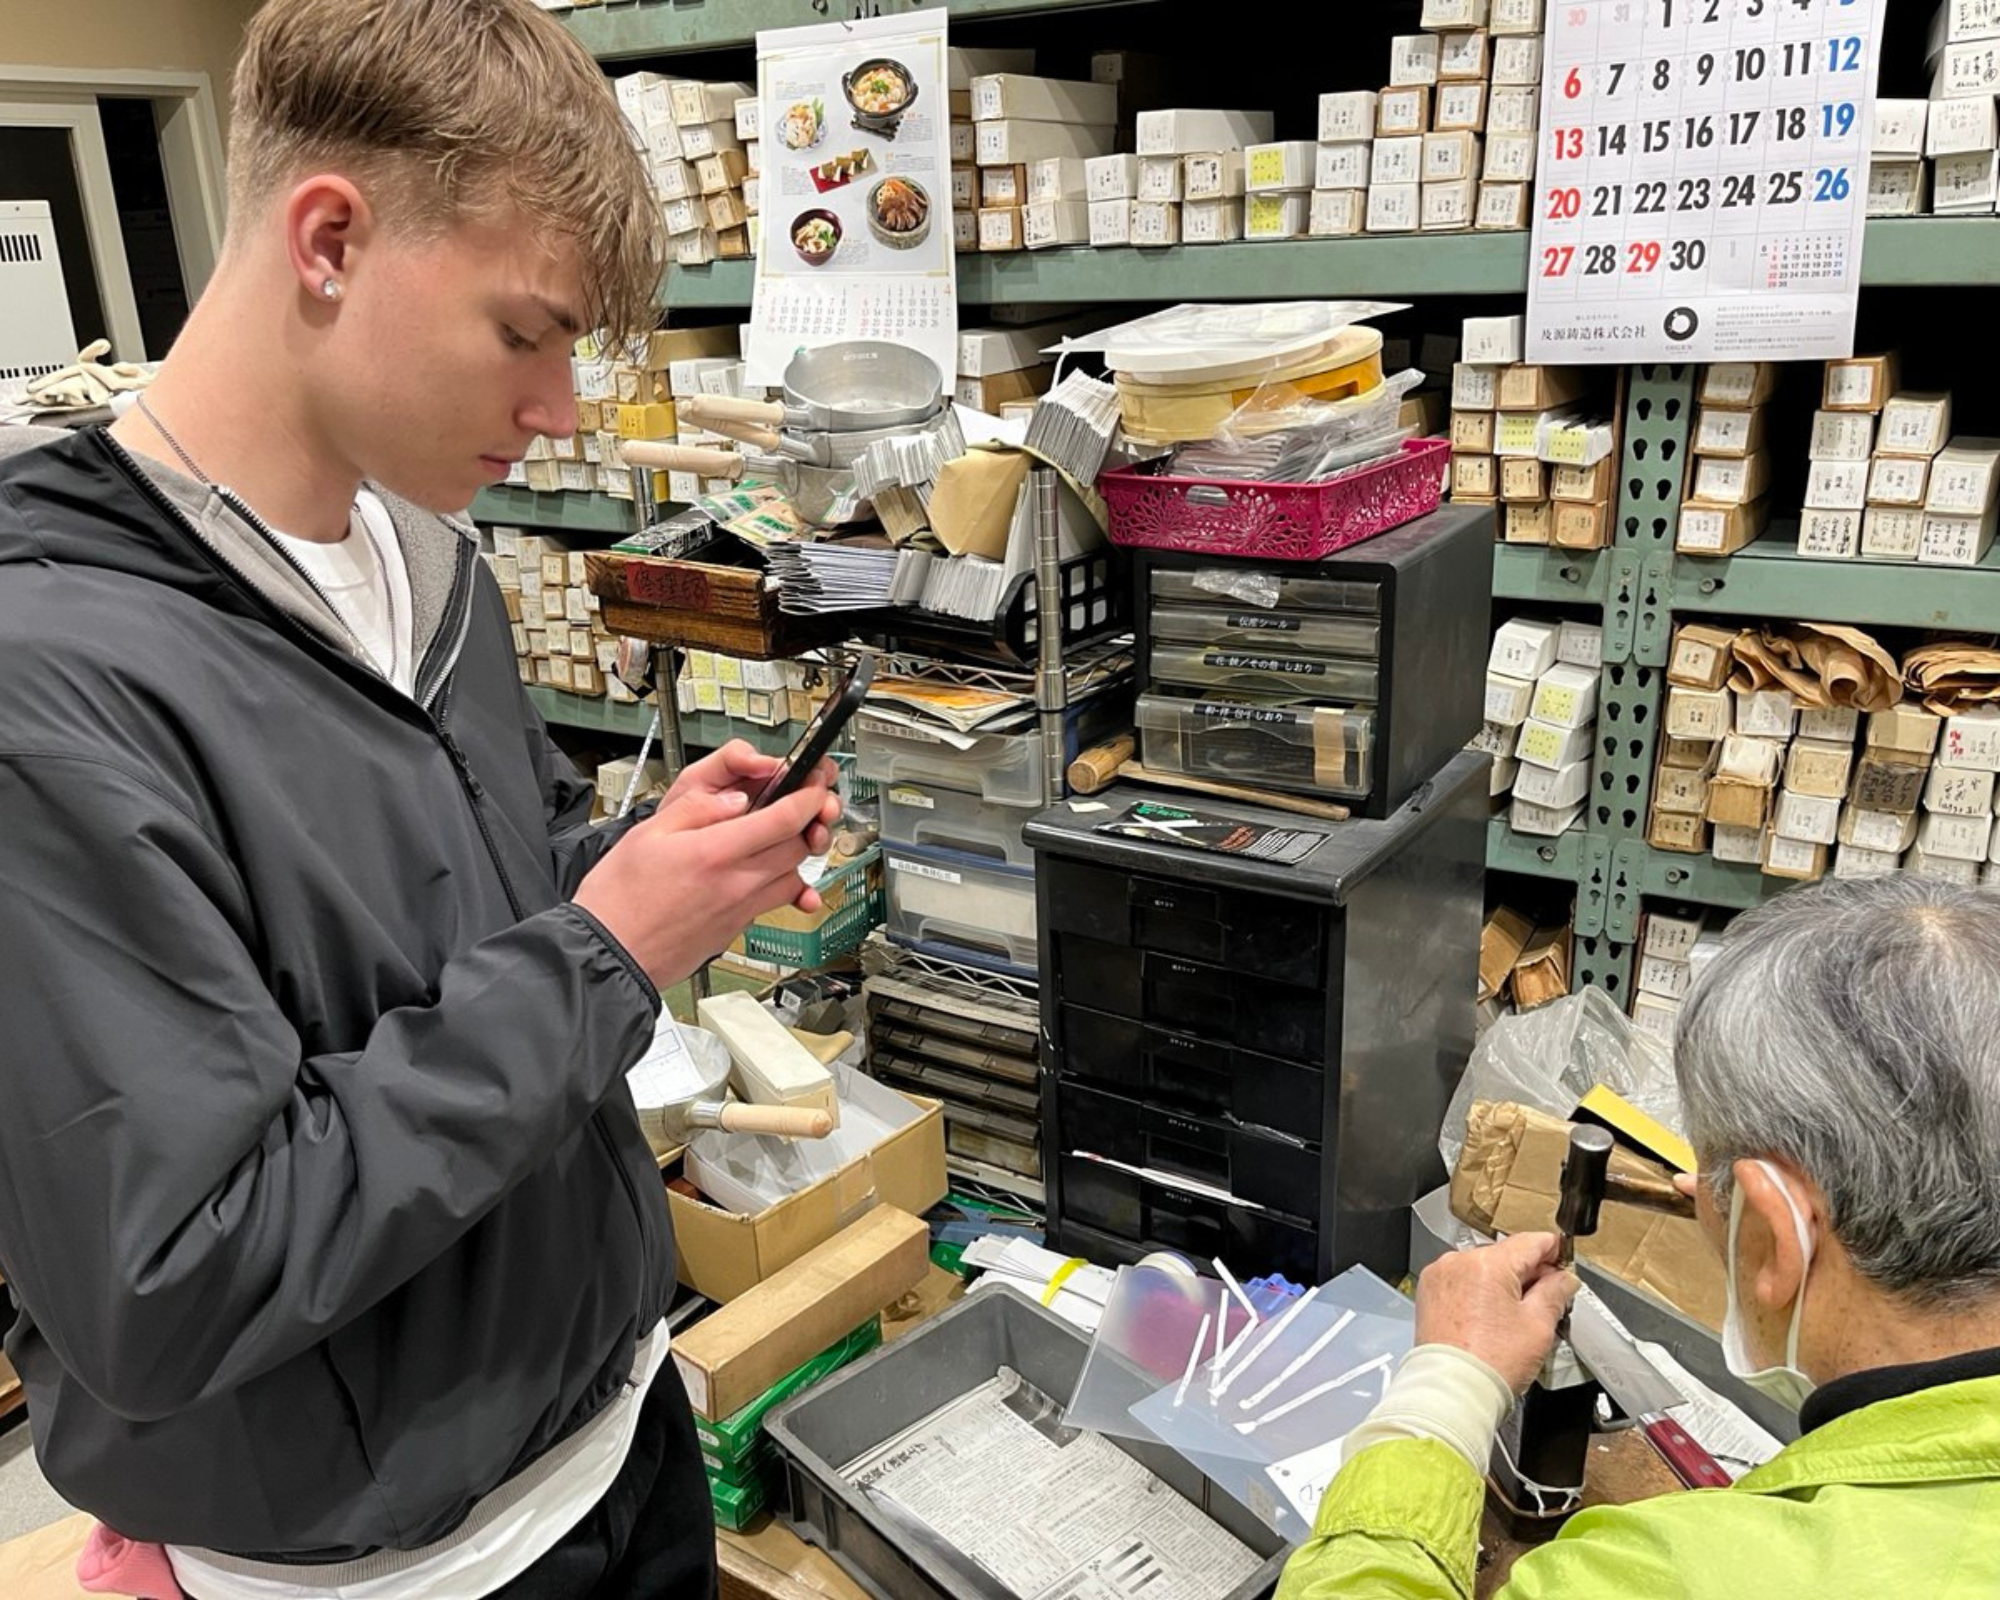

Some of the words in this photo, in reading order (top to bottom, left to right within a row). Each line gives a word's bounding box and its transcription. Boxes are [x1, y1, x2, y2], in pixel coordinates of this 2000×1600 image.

[1662, 0, 1672, 28] 1
[1703, 0, 1719, 23] 2
[1564, 68, 1581, 99] 6
[1607, 63, 1626, 95] 7
[1653, 59, 1670, 90] 8
[1697, 54, 1714, 85] 9
[1736, 48, 1765, 81] 10
[1784, 42, 1811, 76] 11
[1829, 37, 1861, 72] 12
[1555, 128, 1583, 160] 13
[1599, 125, 1626, 156] 14
[1643, 120, 1670, 153] 15
[1686, 116, 1713, 149] 16
[1730, 111, 1760, 145] 17
[1776, 107, 1805, 141] 18
[1823, 103, 1855, 137] 19
[1548, 188, 1581, 219] 20
[1592, 185, 1622, 216] 21
[1633, 182, 1667, 213] 22
[1677, 178, 1710, 210] 23
[1722, 175, 1755, 207] 24
[1767, 171, 1803, 205] 25
[1814, 168, 1849, 201] 26
[1544, 247, 1575, 277] 27
[1584, 245, 1616, 275] 28
[1627, 242, 1661, 273] 29
[1670, 240, 1705, 270] 30
[1284, 661, 1313, 673] しおり
[1256, 711, 1283, 722] しおり
